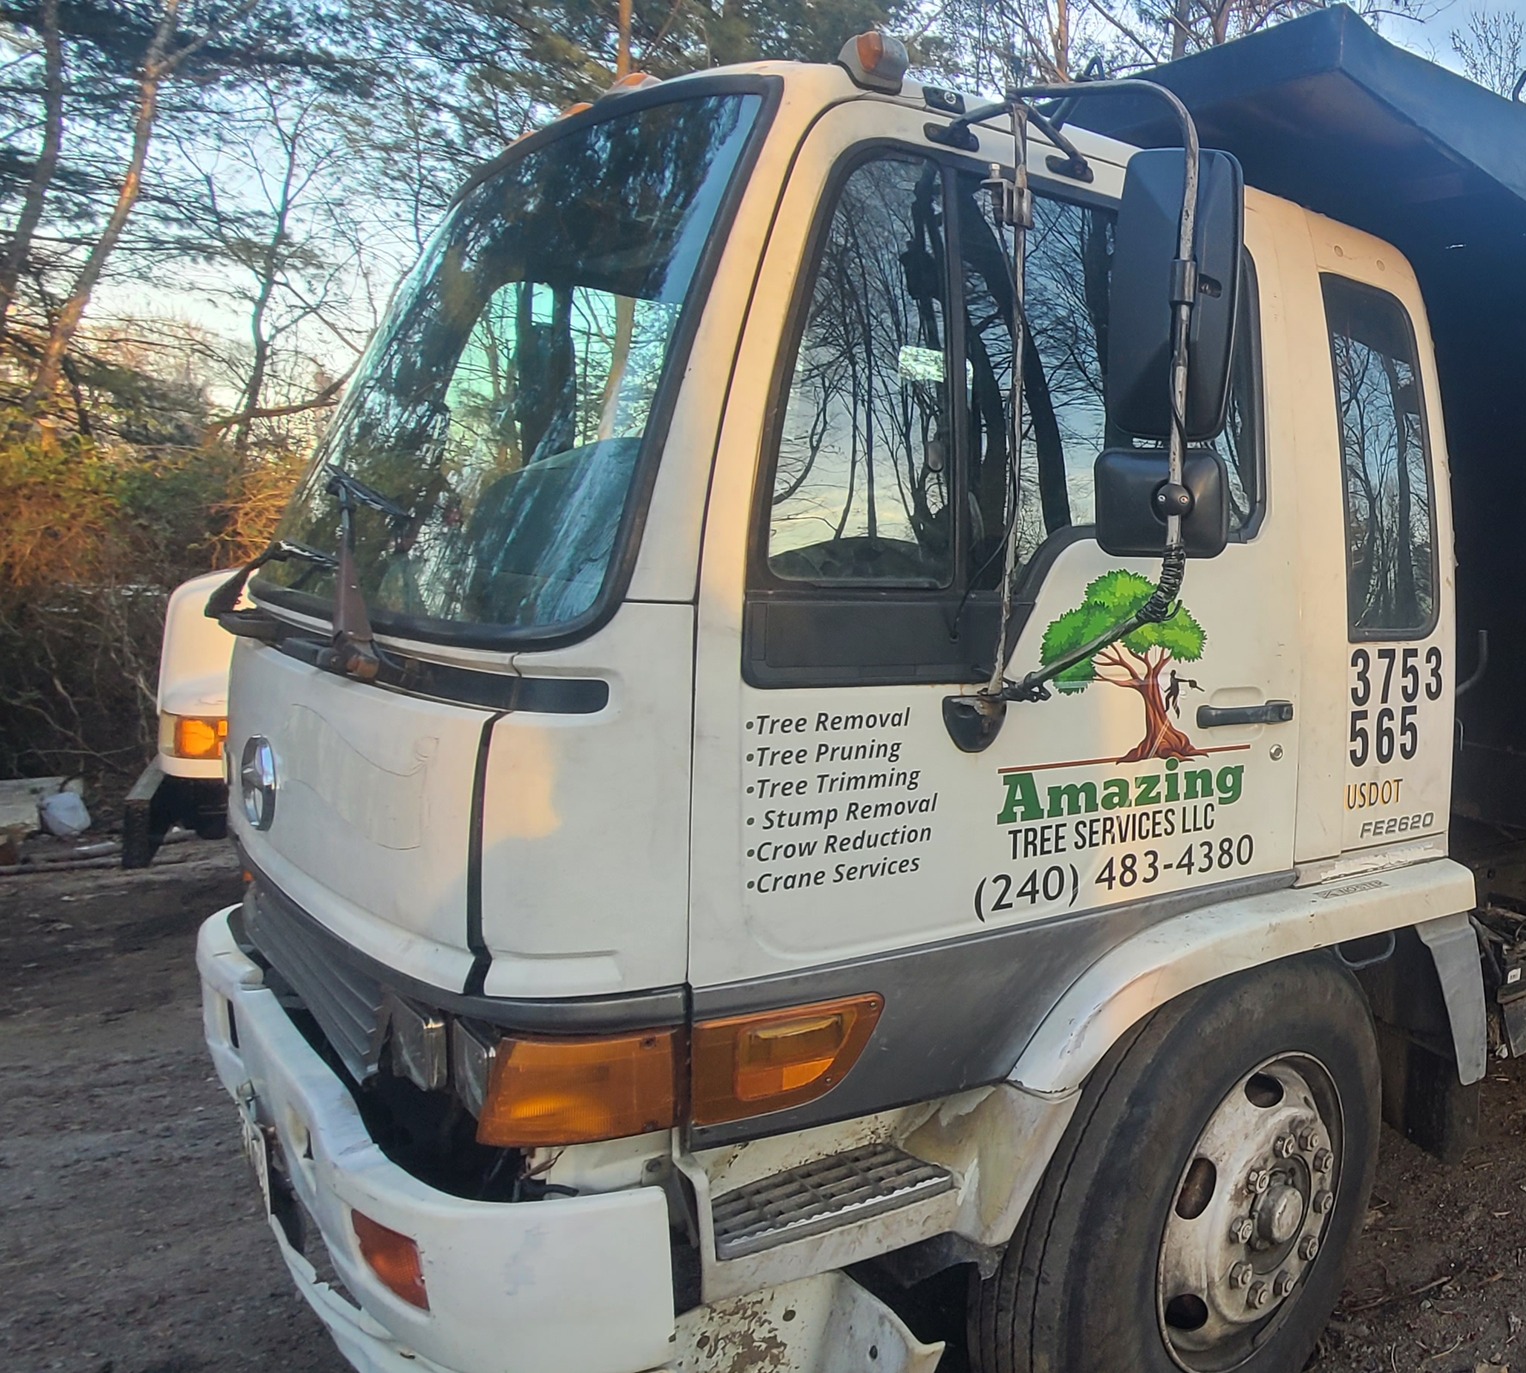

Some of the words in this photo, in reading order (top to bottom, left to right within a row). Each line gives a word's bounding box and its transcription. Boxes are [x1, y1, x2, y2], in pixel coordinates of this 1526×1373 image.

[1350, 646, 1443, 707] 3753
[756, 714, 808, 735] Tree
[815, 706, 911, 732] Removal
[1349, 704, 1418, 767] 565
[757, 746, 808, 767] Tree
[815, 739, 902, 763] Pruning
[757, 778, 808, 799] Tree
[816, 767, 921, 791] Trimming
[997, 758, 1245, 826] Amazing
[1346, 778, 1403, 810] USDOT
[762, 807, 838, 830] Stump
[845, 792, 939, 822] Removal
[1360, 812, 1434, 839] FE2620
[757, 840, 819, 862] Crow
[823, 824, 932, 855] Reduction
[1008, 823, 1067, 860] TREE
[1074, 808, 1176, 850] SERVICES
[1182, 803, 1215, 833] LLC
[757, 869, 826, 894] Crane
[833, 856, 921, 883] Services
[974, 863, 1079, 923] (240)
[1095, 834, 1254, 891] 483-4380
